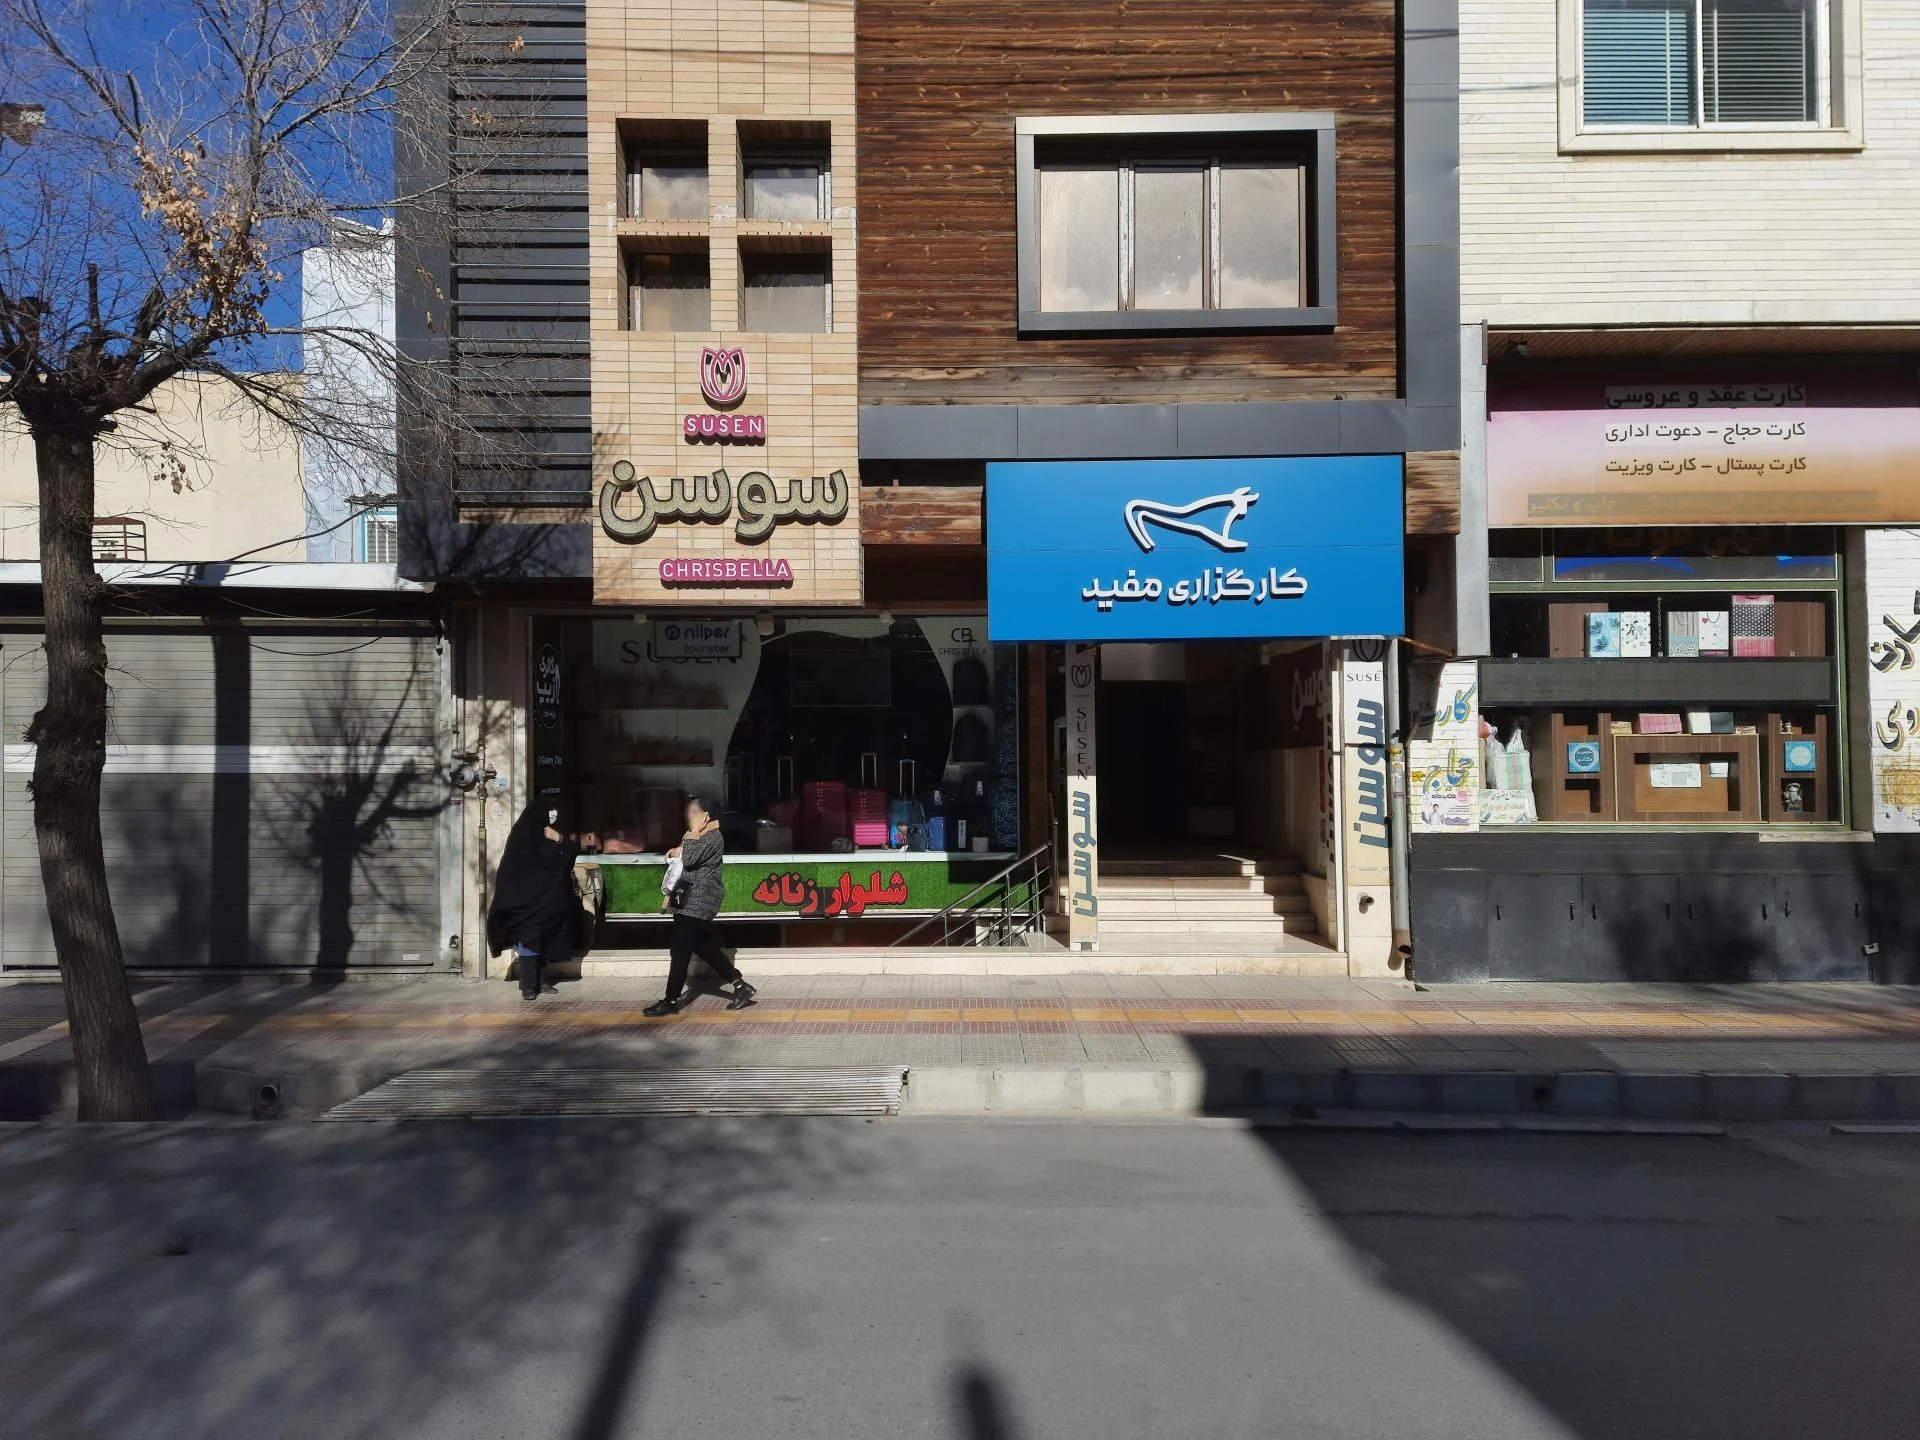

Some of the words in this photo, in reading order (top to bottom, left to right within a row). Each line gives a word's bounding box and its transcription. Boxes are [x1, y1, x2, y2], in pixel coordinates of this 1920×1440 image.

[1606, 392, 1681, 408] عروسی
[1687, 392, 1699, 407] و
[1707, 386, 1746, 402] عقد
[1753, 385, 1805, 407] کارت
[686, 416, 764, 435] SUSEN
[1605, 423, 1649, 442] اداری
[1655, 424, 1702, 441] دعوت
[1722, 423, 1762, 445] حجاج
[1766, 421, 1806, 440] کارت
[1605, 459, 1654, 476] ویزیت
[1658, 457, 1697, 475] کارت
[1717, 457, 1765, 477] پستال
[1769, 456, 1807, 475] کارت
[600, 459, 849, 545] سوسن
[662, 561, 791, 580] CHRISBELLA
[1082, 568, 1164, 612] مفید
[1167, 565, 1309, 606] کارگزاری
[684, 624, 731, 641] nilper
[1076, 706, 1089, 782] SUSEN
[1354, 698, 1392, 849] سوسن
[1072, 789, 1098, 918] سوسن
[752, 871, 820, 917] زنانه
[825, 870, 908, 917] شلوار
